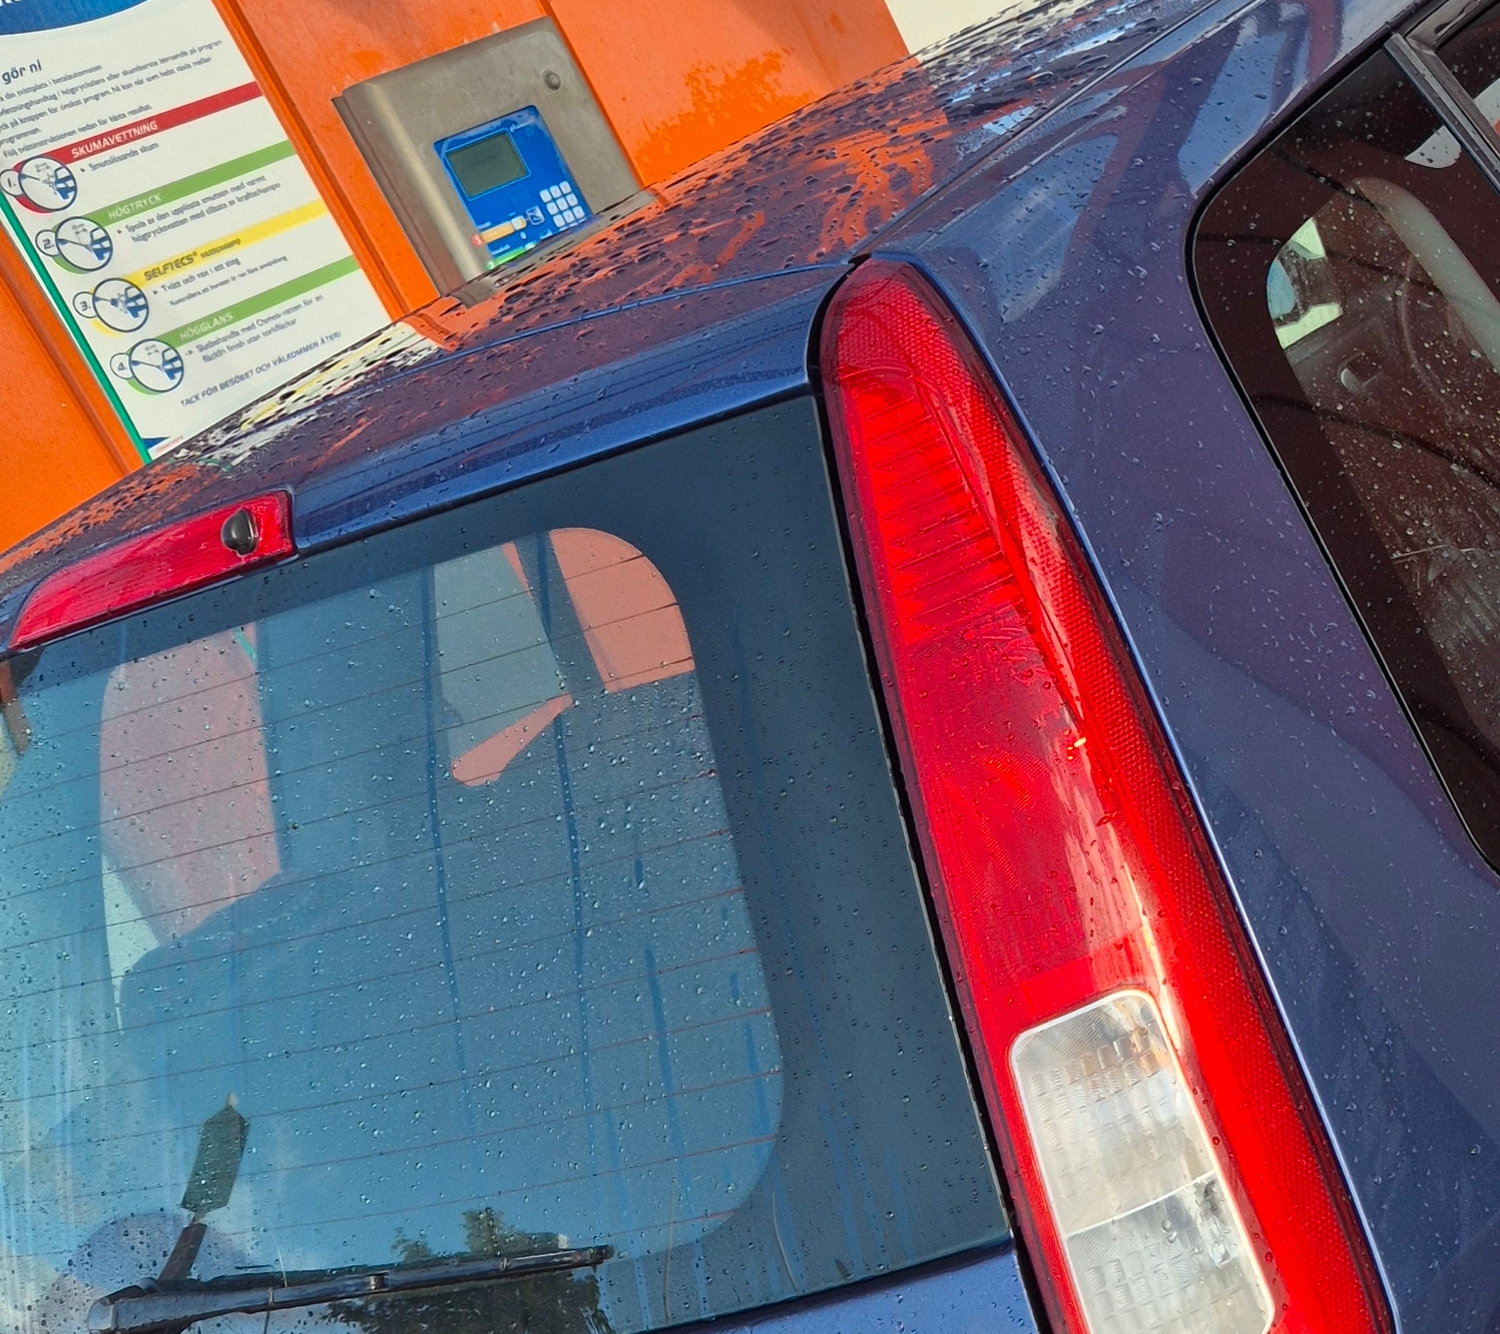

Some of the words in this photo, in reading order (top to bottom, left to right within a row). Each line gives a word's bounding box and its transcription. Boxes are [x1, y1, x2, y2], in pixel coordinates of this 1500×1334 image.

[2, 67, 26, 85] gör
[71, 120, 158, 159] SKUMAVETTNING
[108, 193, 162, 220] HÖGTRYCK
[180, 311, 234, 340] HÖGGLANS
[180, 392, 201, 408] TACK
[201, 385, 219, 398] FÖR
[219, 370, 254, 391] BESÖKET
[255, 362, 271, 375] OCH
